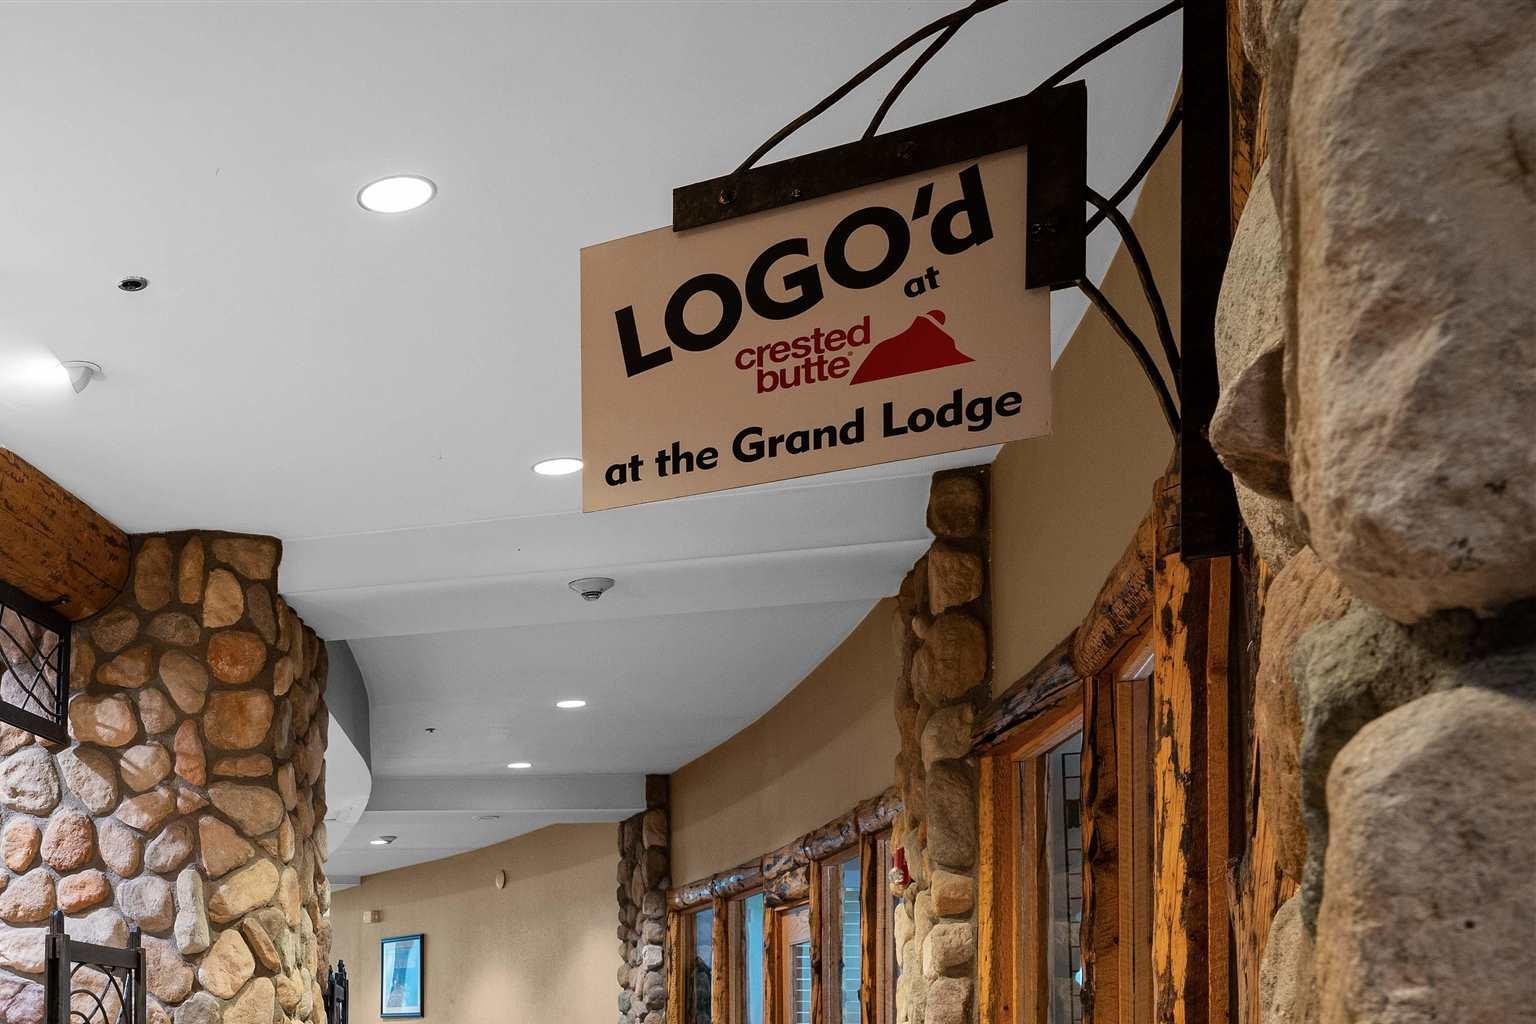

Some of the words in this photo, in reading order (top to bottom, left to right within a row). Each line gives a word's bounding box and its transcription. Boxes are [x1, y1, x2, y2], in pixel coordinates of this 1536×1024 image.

[615, 164, 994, 378] LOGO'd
[903, 265, 941, 299] at
[735, 315, 872, 370] crested
[756, 354, 852, 395] butte
[605, 453, 642, 487] at
[655, 441, 719, 479] the
[732, 407, 866, 464] Grand
[882, 388, 1023, 439] Lodge
